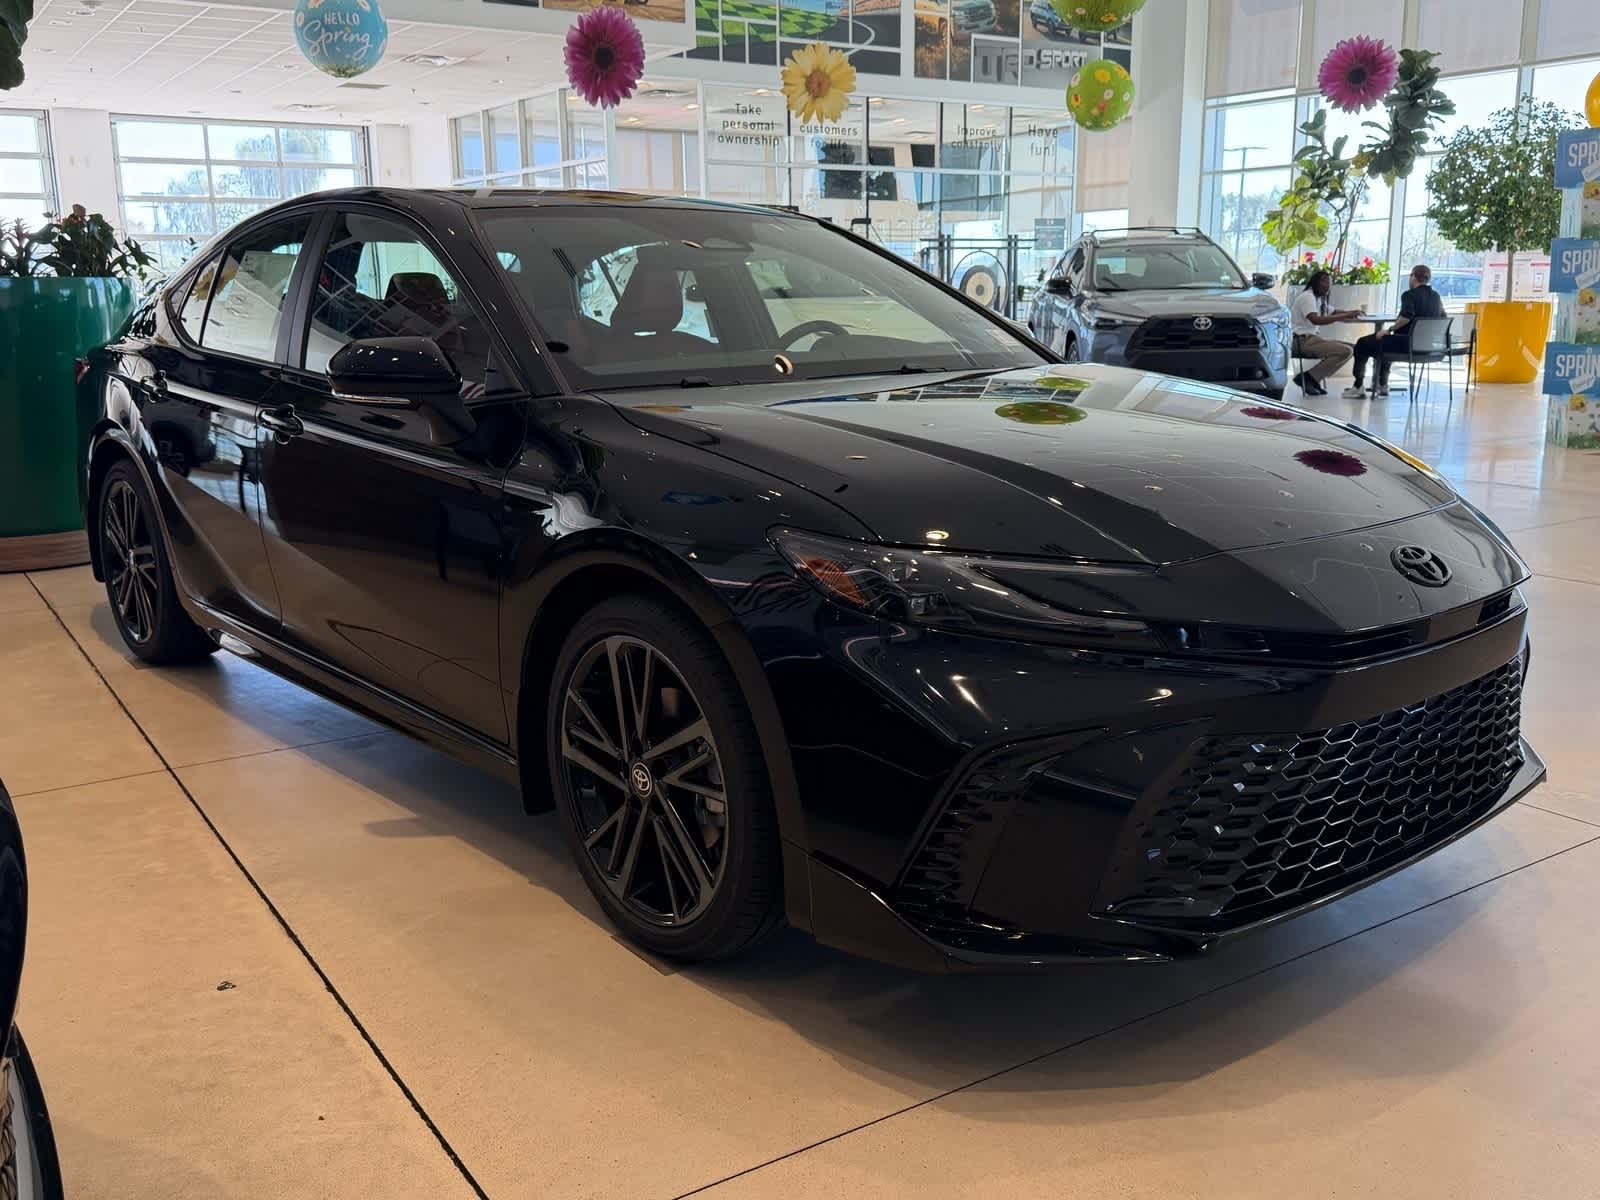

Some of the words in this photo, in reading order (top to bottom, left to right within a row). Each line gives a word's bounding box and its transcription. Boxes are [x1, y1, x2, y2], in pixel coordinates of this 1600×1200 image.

[324, 11, 360, 26] HELLO
[302, 19, 373, 61] Spring
[1038, 49, 1088, 70] SPORT
[735, 103, 762, 116] Take
[722, 119, 775, 132] personal
[799, 123, 858, 136] customers
[957, 123, 998, 137] Improve
[1028, 123, 1058, 138] Have
[717, 134, 780, 149] ownership
[1030, 141, 1056, 157] fun!
[1568, 141, 1600, 167] SPR
[1561, 240, 1600, 274] SPRI
